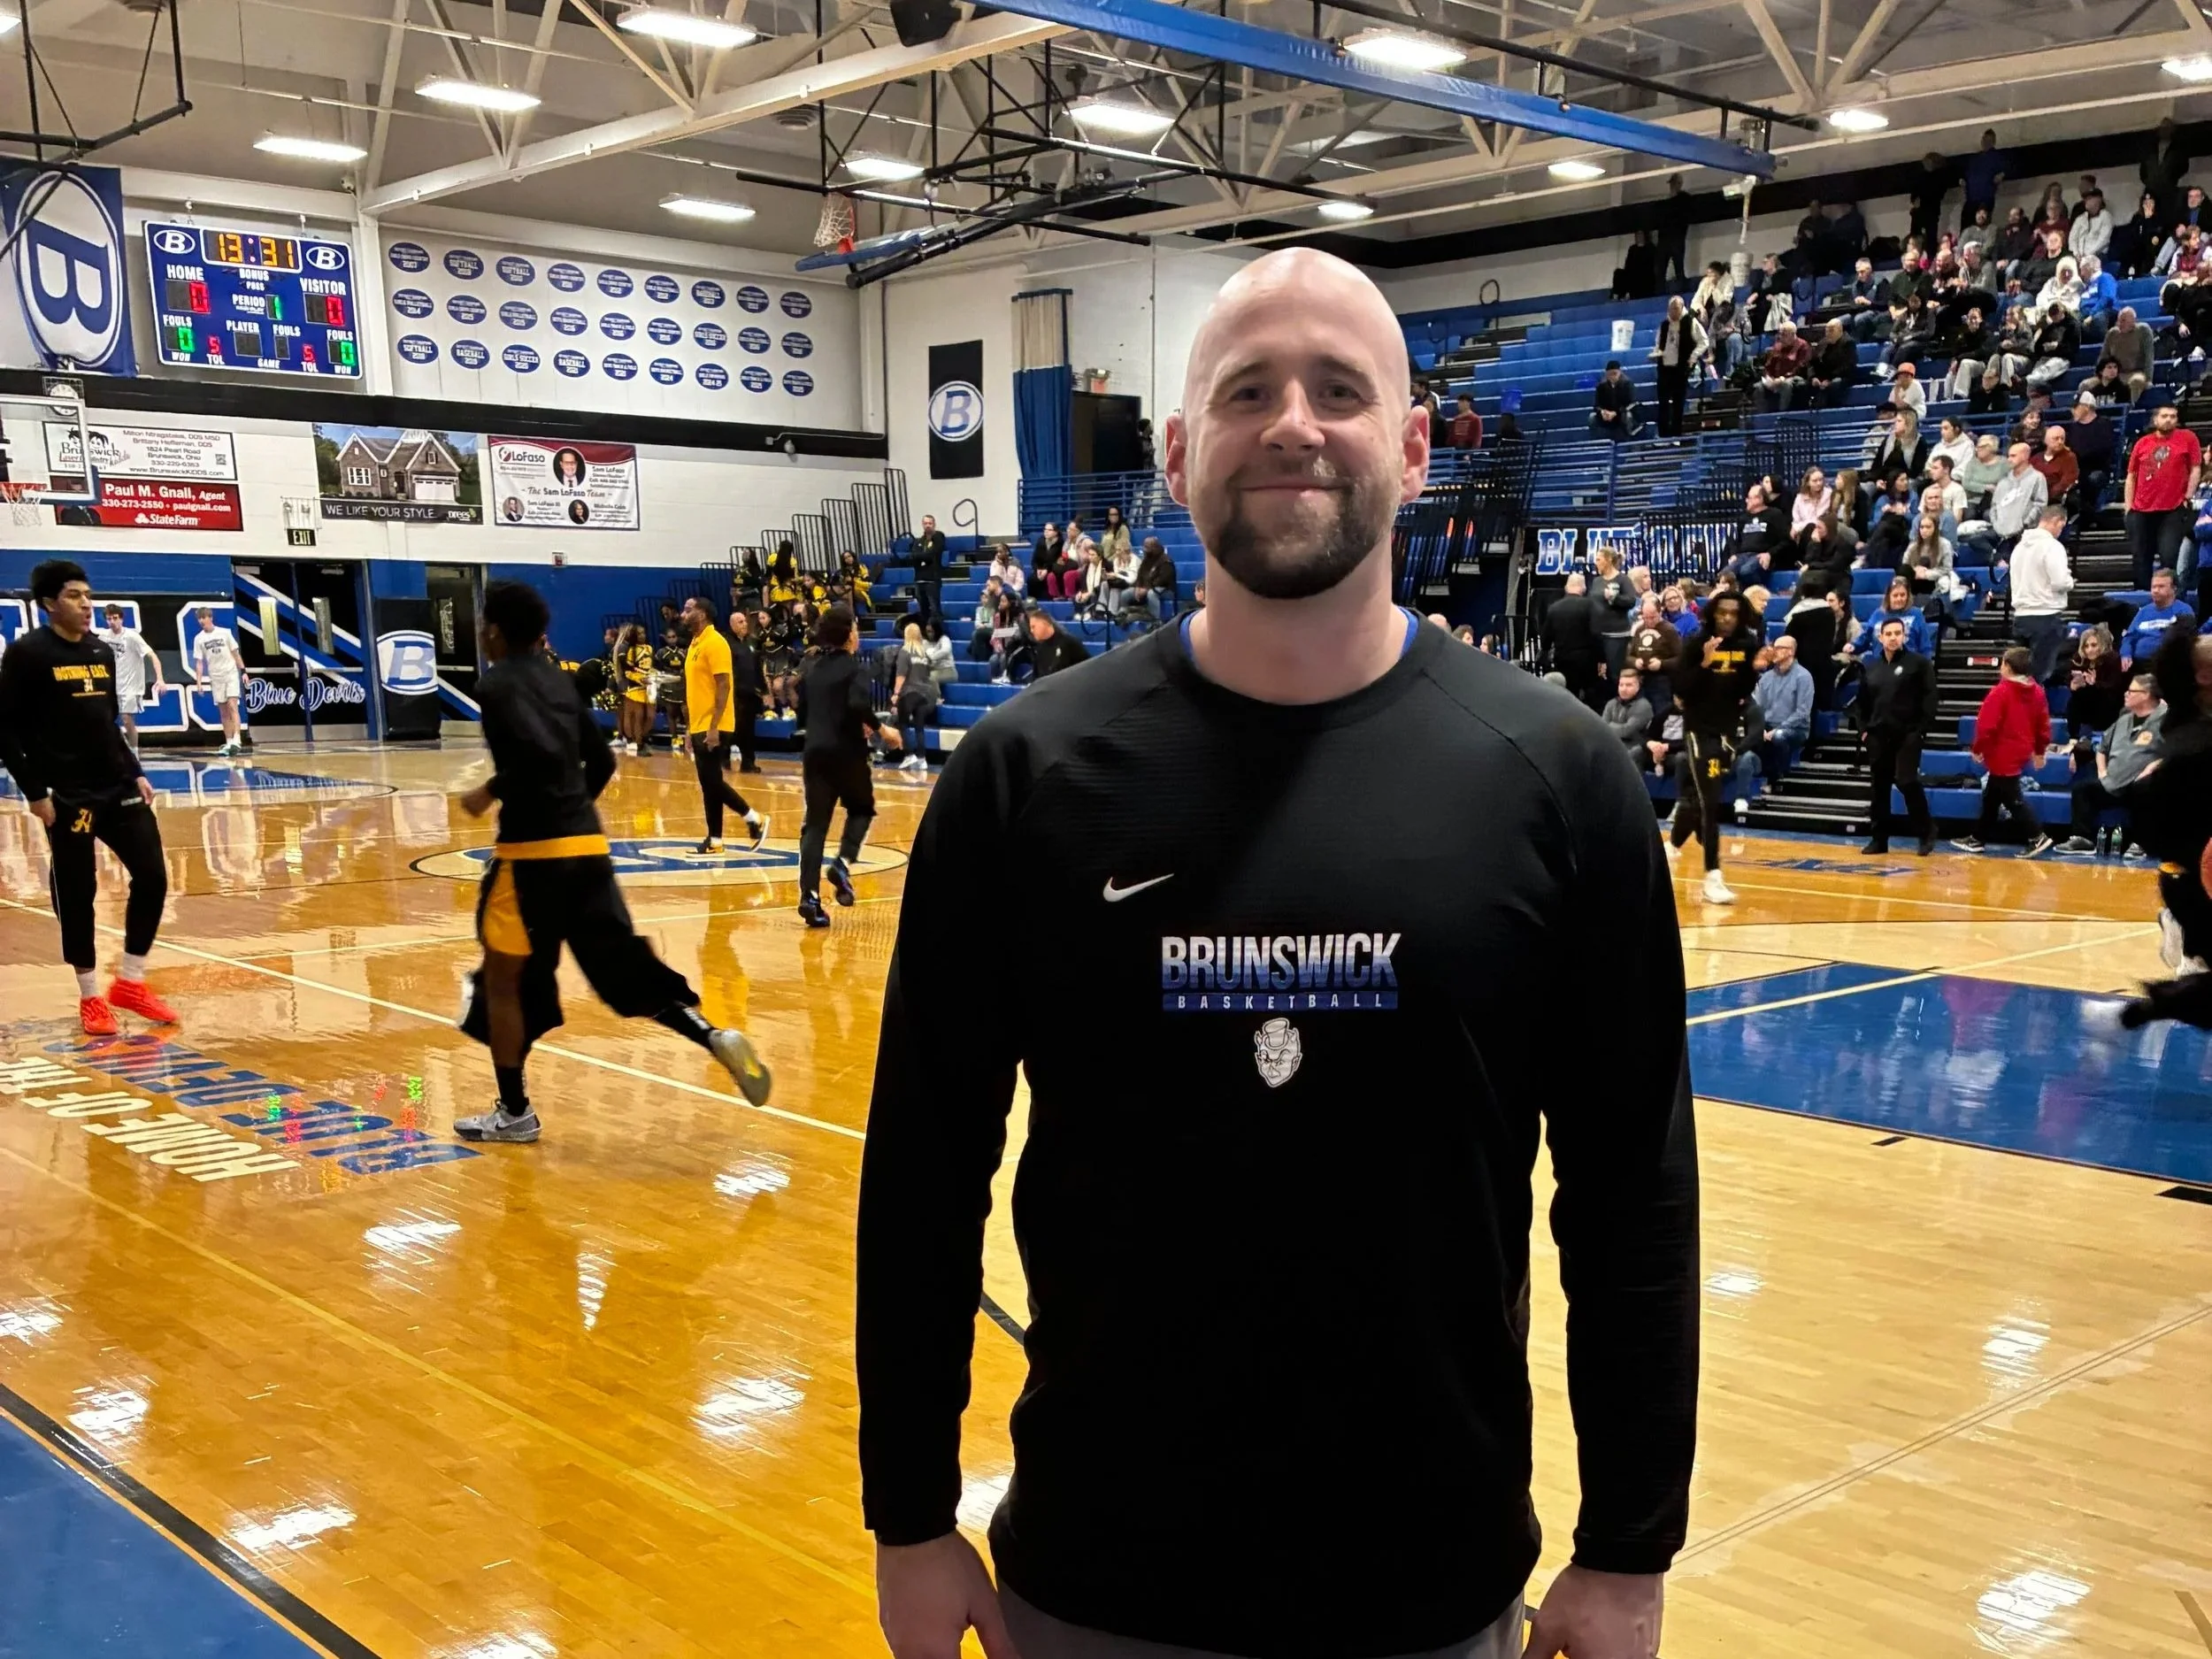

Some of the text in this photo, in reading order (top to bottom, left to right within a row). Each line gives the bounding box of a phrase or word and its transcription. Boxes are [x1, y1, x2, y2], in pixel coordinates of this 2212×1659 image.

[219, 234, 294, 268] 13:31
[165, 264, 205, 281] HOME
[239, 268, 269, 281] BONUS
[300, 277, 346, 296] VISITOR
[189, 282, 210, 312] 0
[232, 294, 265, 307] PERIOD
[326, 296, 344, 326] 0
[163, 314, 192, 327] FOULS
[226, 319, 259, 333] PLAYER
[273, 324, 301, 336] FOULS
[326, 329, 353, 341] FOULS
[179, 326, 194, 352] 0
[172, 352, 190, 362] WON
[206, 353, 225, 365] TOL
[341, 341, 354, 365] 0
[257, 357, 280, 369] GAME
[301, 361, 319, 373] TOL
[334, 365, 351, 375] WON
[512, 450, 546, 463] LoFaso
[104, 483, 226, 502] Paul M. Gnall, Agent
[326, 504, 342, 515] WE
[346, 505, 368, 515] LIKE
[371, 506, 400, 518] YOUR
[293, 531, 311, 545] EXIT
[245, 676, 366, 713] Blue Devils
[1161, 933, 1402, 990] BRUNSWICK
[1178, 994, 1382, 1010] BASKETBALL
[21, 1091, 153, 1118] OF
[219, 1100, 485, 1176] BLUE
[81, 1112, 302, 1182] HOME
